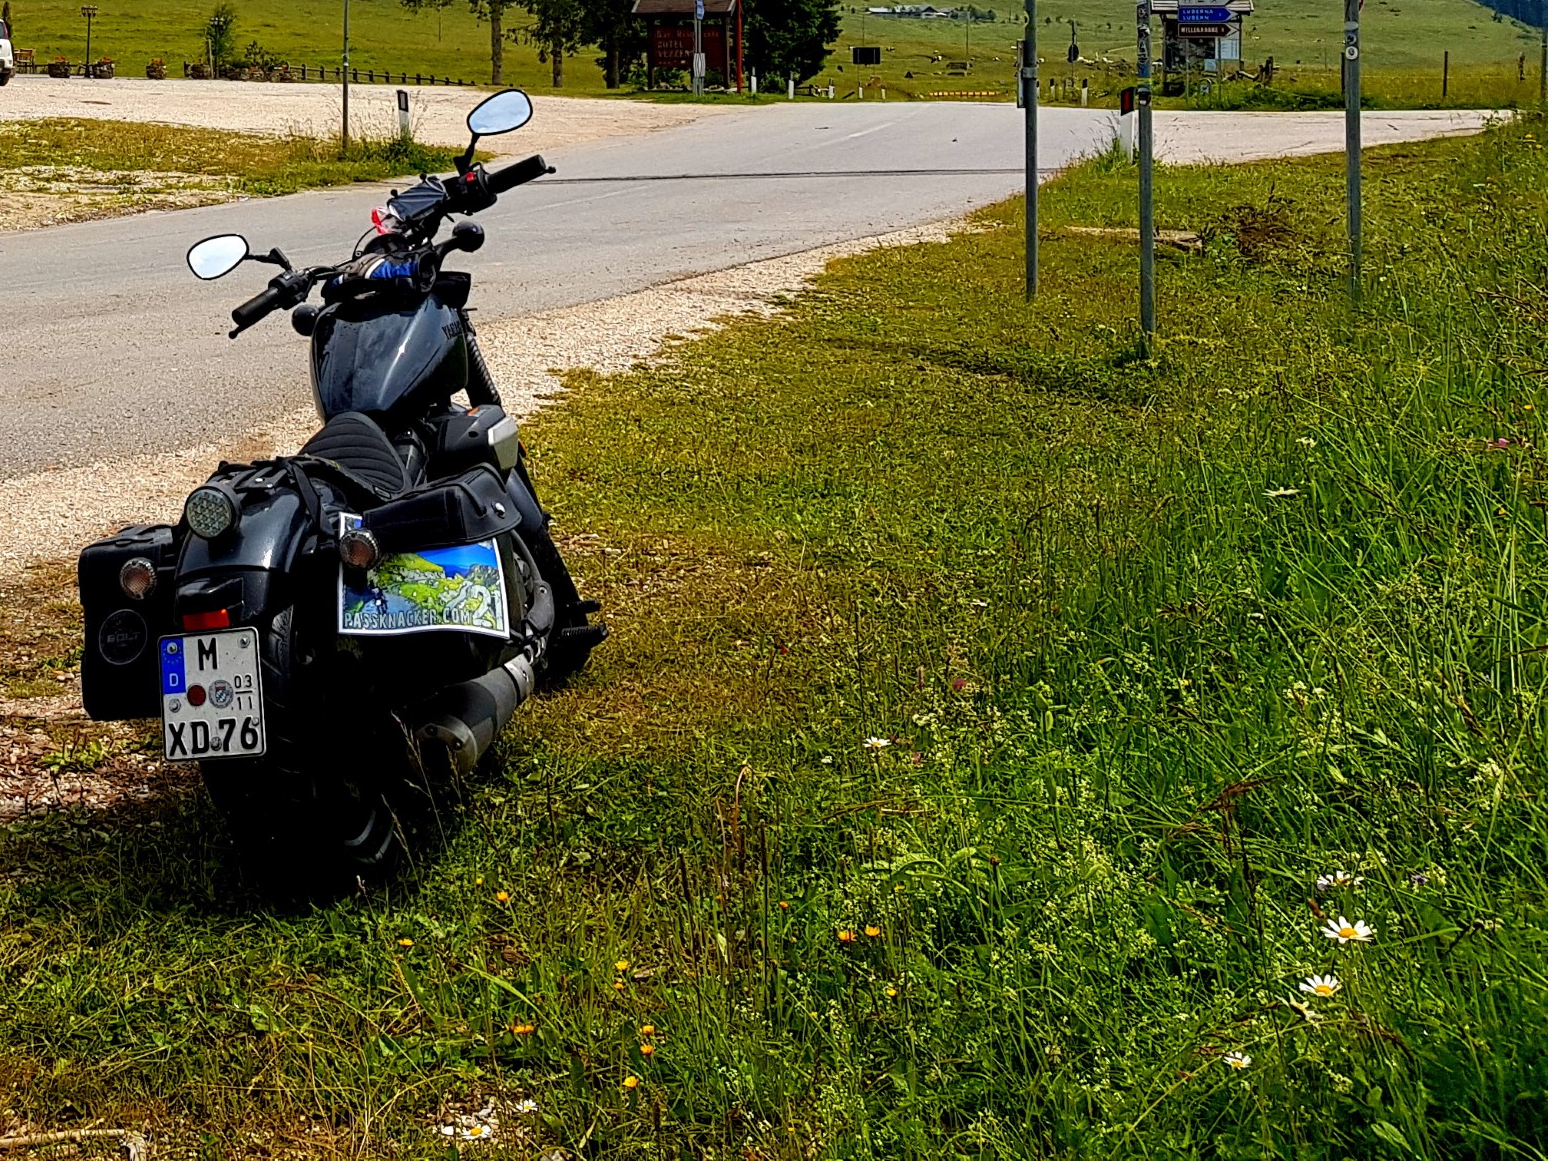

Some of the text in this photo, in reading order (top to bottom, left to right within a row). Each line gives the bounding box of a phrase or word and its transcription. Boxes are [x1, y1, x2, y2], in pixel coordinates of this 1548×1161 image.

[344, 607, 472, 629] PASSKNACKER.COM
[197, 637, 218, 671] M
[169, 673, 179, 687] D
[234, 674, 253, 689] 03
[237, 695, 253, 710] 11
[168, 716, 259, 757] XD 76
